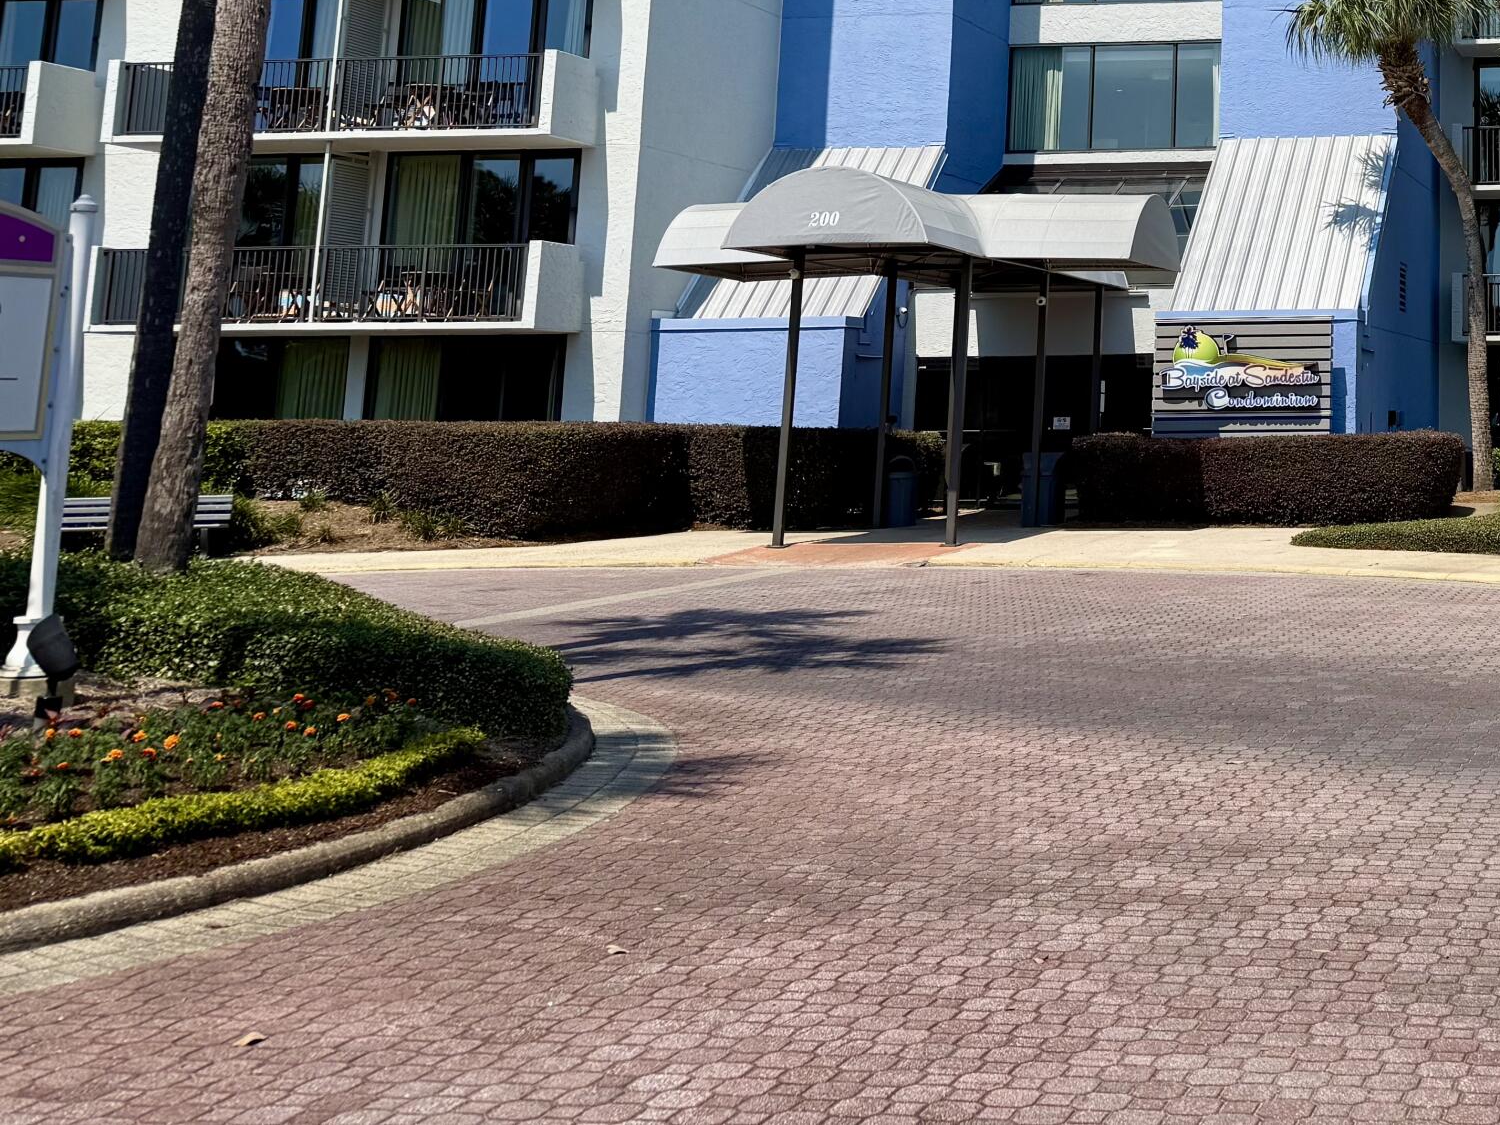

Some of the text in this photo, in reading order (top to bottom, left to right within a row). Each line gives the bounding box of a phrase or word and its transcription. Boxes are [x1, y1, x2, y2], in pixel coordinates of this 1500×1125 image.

[808, 211, 840, 227] 200
[1160, 364, 1319, 391] Bayside at Sandestin
[1205, 387, 1318, 410] Condominium
